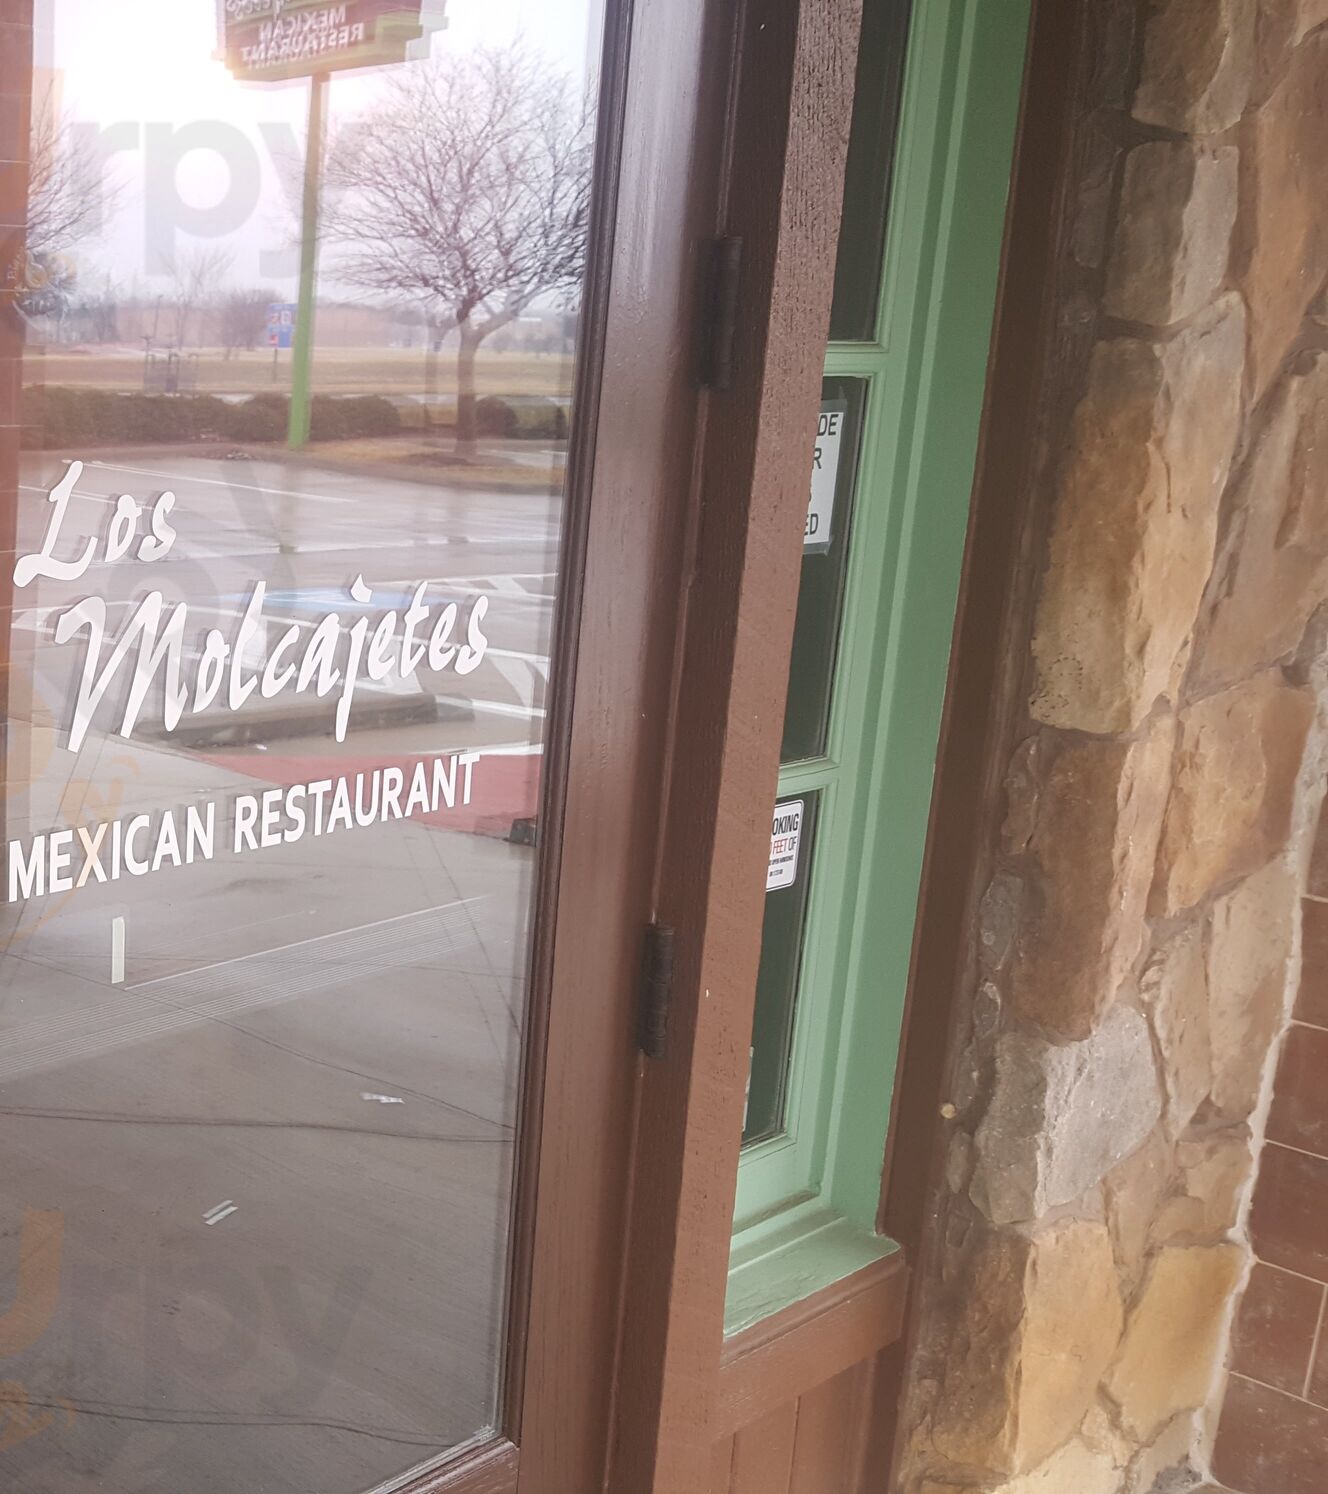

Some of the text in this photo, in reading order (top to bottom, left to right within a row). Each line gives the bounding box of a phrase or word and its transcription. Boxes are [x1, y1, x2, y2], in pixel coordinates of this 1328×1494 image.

[817, 414, 839, 437] DE
[13, 461, 176, 587] Los
[54, 573, 488, 752] Molcajetes
[8, 752, 480, 903] MEXICAN RESTAURANT
[772, 813, 799, 836] OKING
